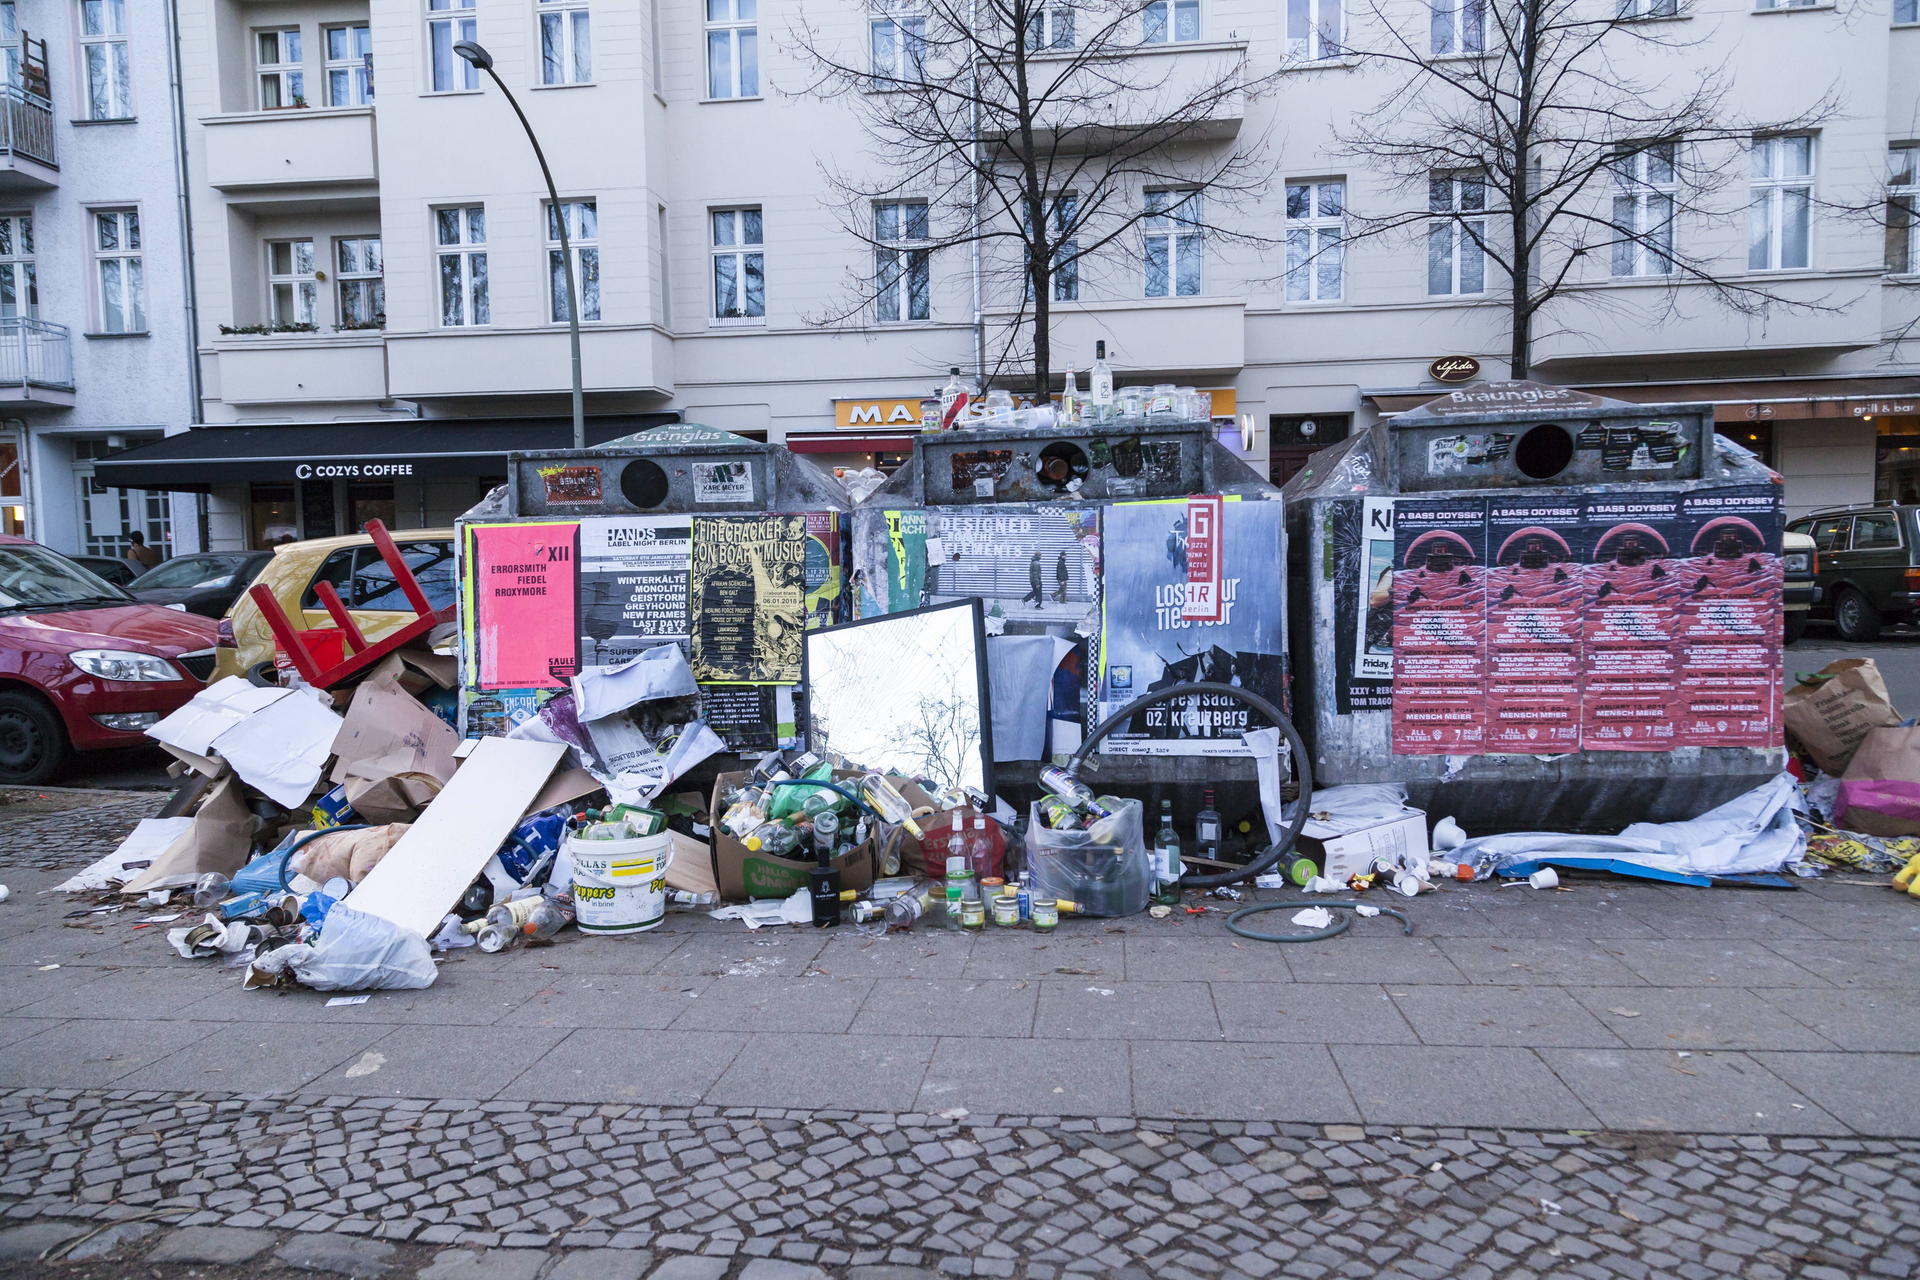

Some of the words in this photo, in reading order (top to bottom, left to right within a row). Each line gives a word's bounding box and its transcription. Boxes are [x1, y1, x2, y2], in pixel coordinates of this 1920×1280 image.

[1450, 388, 1569, 403] Braunglas
[1854, 401, 1878, 416] grill
[1894, 400, 1914, 412] bar
[633, 430, 721, 443] Grünglas
[316, 465, 359, 476] COZYS
[363, 464, 413, 476] COFFEE
[1693, 498, 1723, 506] BASS
[1724, 497, 1774, 505] ODYSSEY
[1531, 508, 1580, 516] ODYSSEY
[1596, 505, 1626, 513] BASS
[1627, 504, 1677, 512] ODYSSEY
[1407, 512, 1435, 520] BASS
[940, 517, 1031, 532] DESIGNED
[607, 528, 656, 541] HANDS
[700, 520, 782, 542] FIRECRACKER
[547, 545, 569, 562] XII
[699, 542, 715, 563] ON
[763, 541, 803, 562] MUSIC
[491, 564, 547, 574] ERRORSMITH
[517, 575, 547, 584] FIEDEL
[617, 574, 687, 585] WINTERKÄLTE
[495, 587, 547, 597] RROXYMORE
[635, 585, 686, 593] MONOLITH
[630, 593, 686, 602] GEISTFORM
[625, 602, 686, 610] GREYHOUND
[622, 611, 644, 619] NEW
[647, 610, 686, 619] FRAMES
[632, 620, 658, 628] LAST
[660, 619, 686, 628] DAYS
[643, 626, 656, 634] OF
[659, 626, 686, 635] S.E.X.
[609, 648, 645, 656] SUPERS
[1349, 686, 1370, 695] XXXY
[504, 696, 537, 713] ENCORE
[1350, 697, 1367, 706] TOM
[1368, 697, 1392, 706] TRAGO
[1146, 711, 1167, 727] 02.
